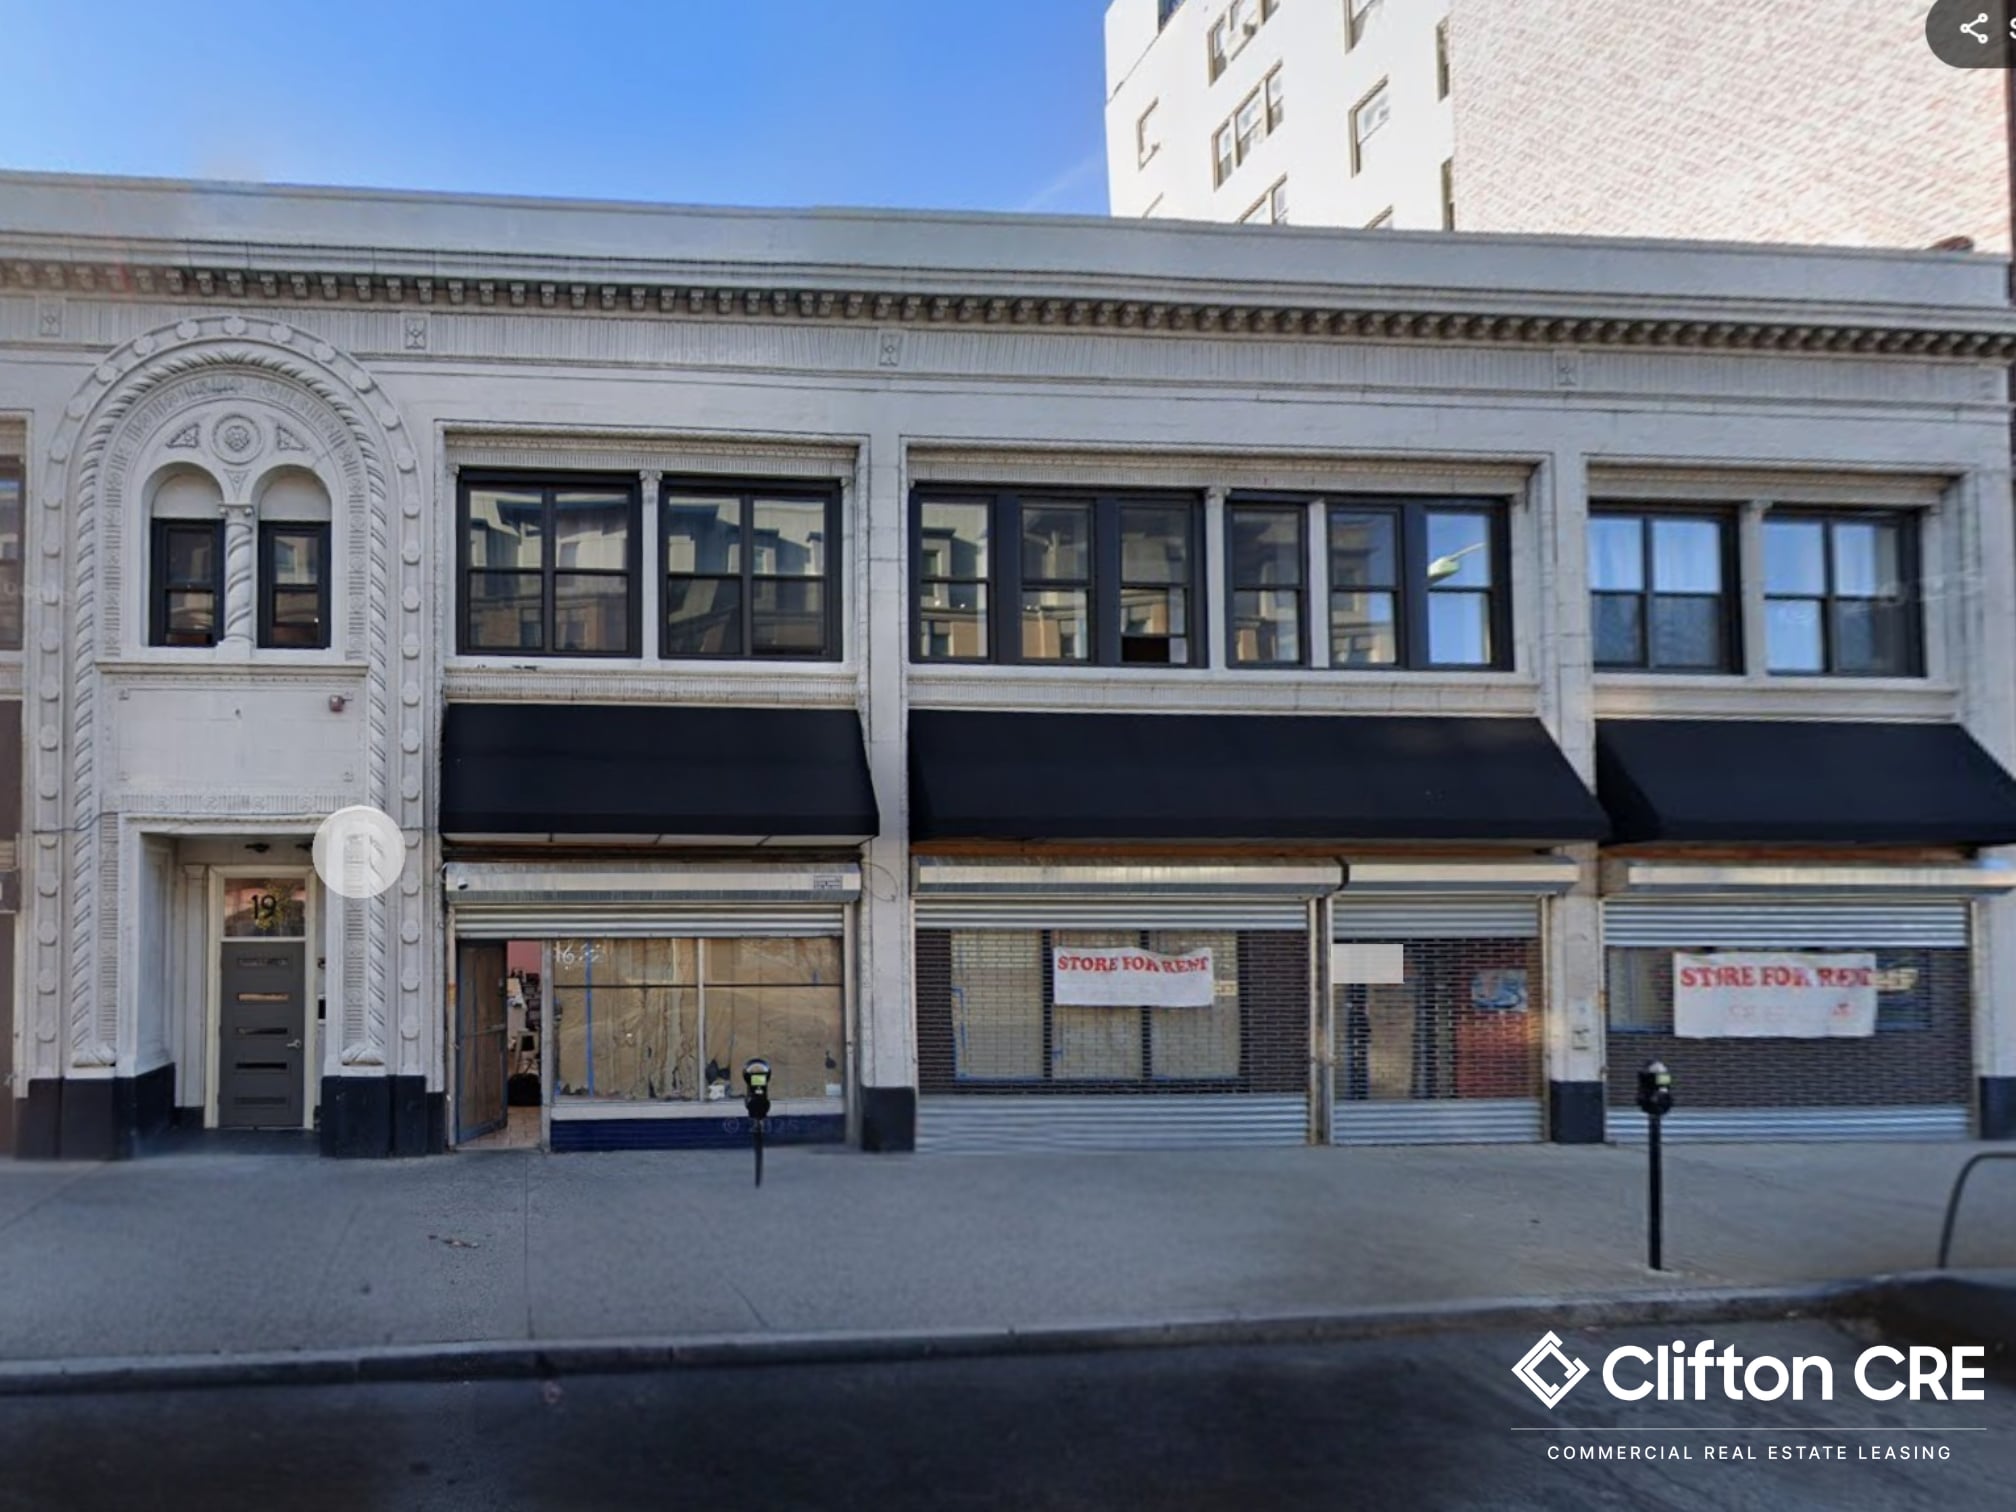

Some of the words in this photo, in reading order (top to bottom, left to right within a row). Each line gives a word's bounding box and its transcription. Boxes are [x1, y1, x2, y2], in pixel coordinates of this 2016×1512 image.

[252, 895, 276, 919] 19
[1057, 956, 1119, 971] STORE
[1681, 966, 1755, 987] STRE
